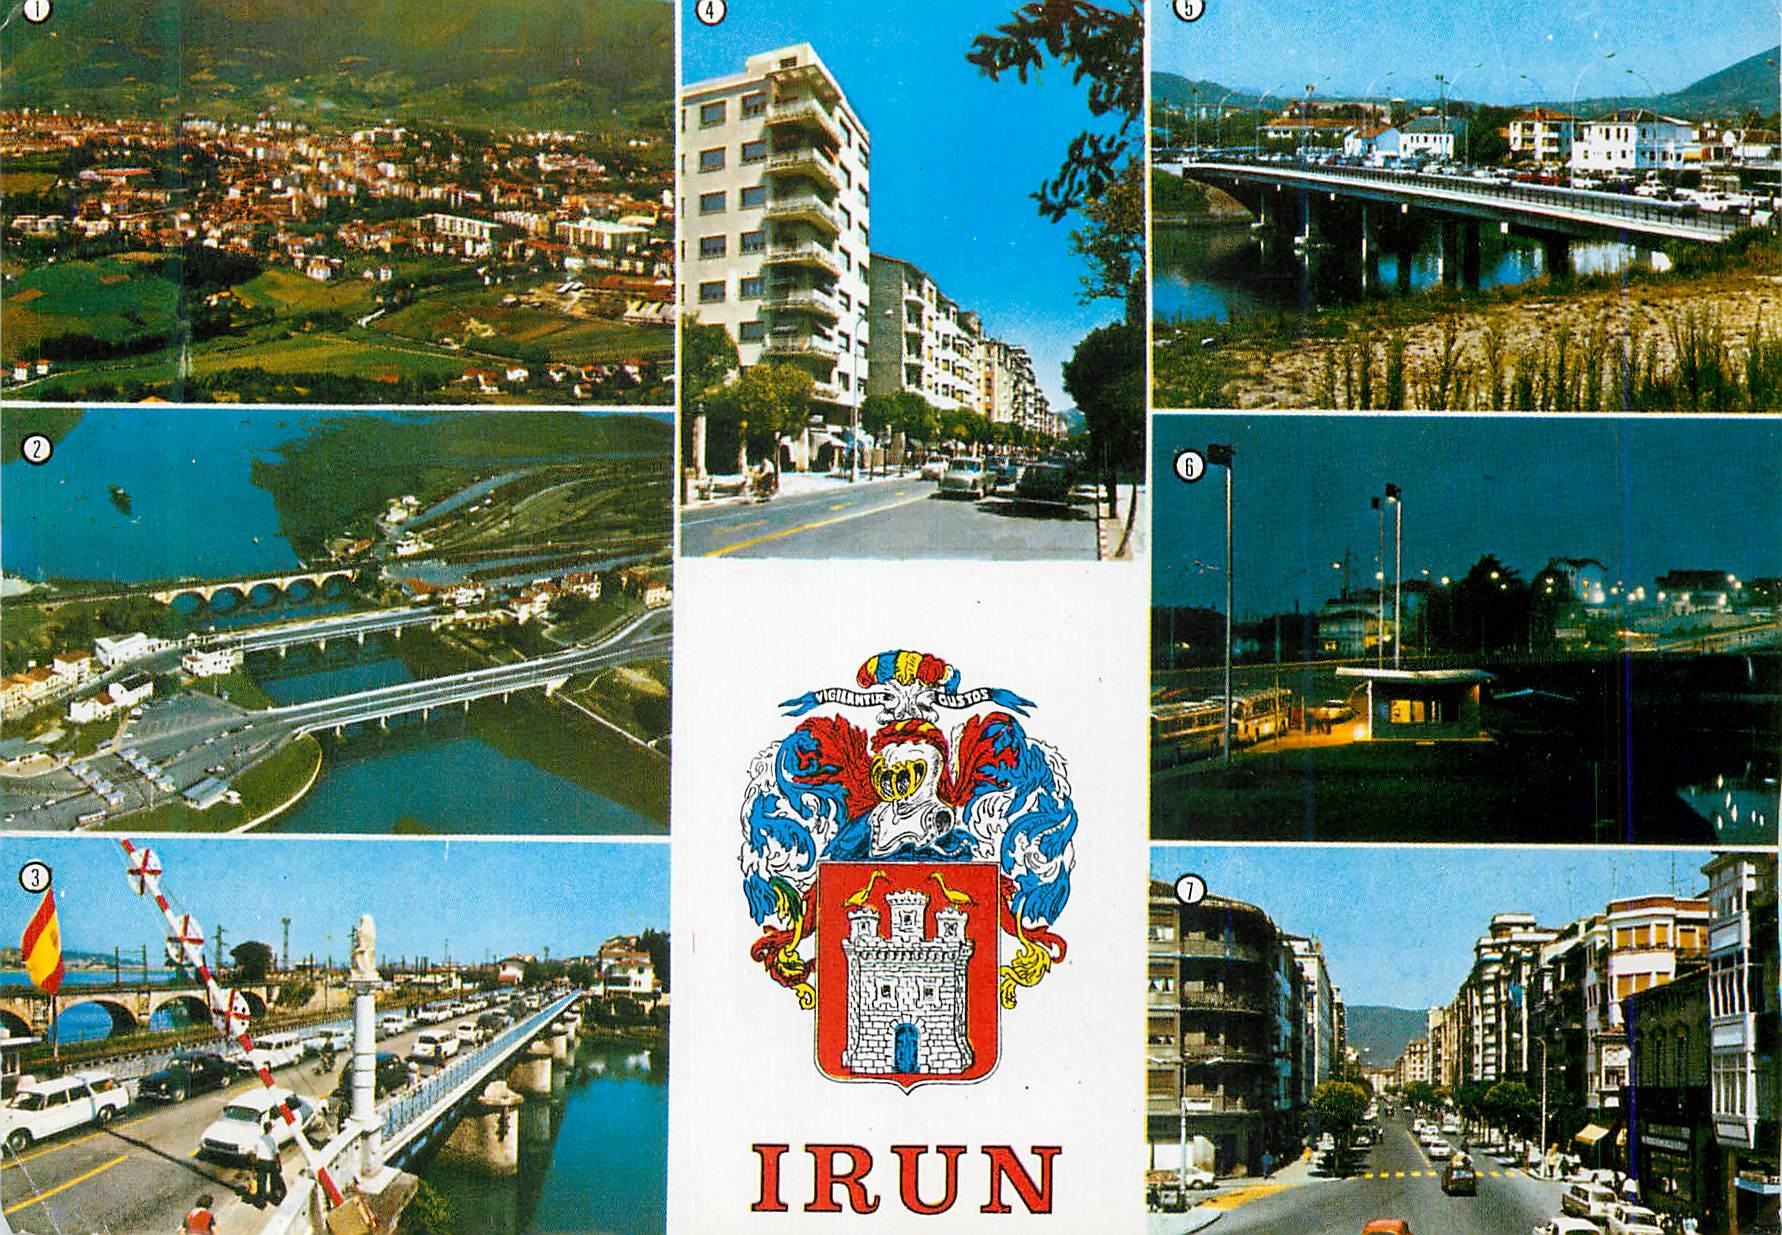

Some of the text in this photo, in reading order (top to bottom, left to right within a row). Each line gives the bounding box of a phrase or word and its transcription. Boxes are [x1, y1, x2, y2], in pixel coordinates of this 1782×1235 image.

[33, 0, 40, 18] 1
[706, 1, 714, 20] 4
[1184, 0, 1193, 17] 5
[33, 441, 41, 460] 2
[1185, 457, 1195, 476] 6
[31, 867, 40, 886] 3
[1187, 881, 1195, 900] 7
[751, 1143, 1063, 1215] IRUN
